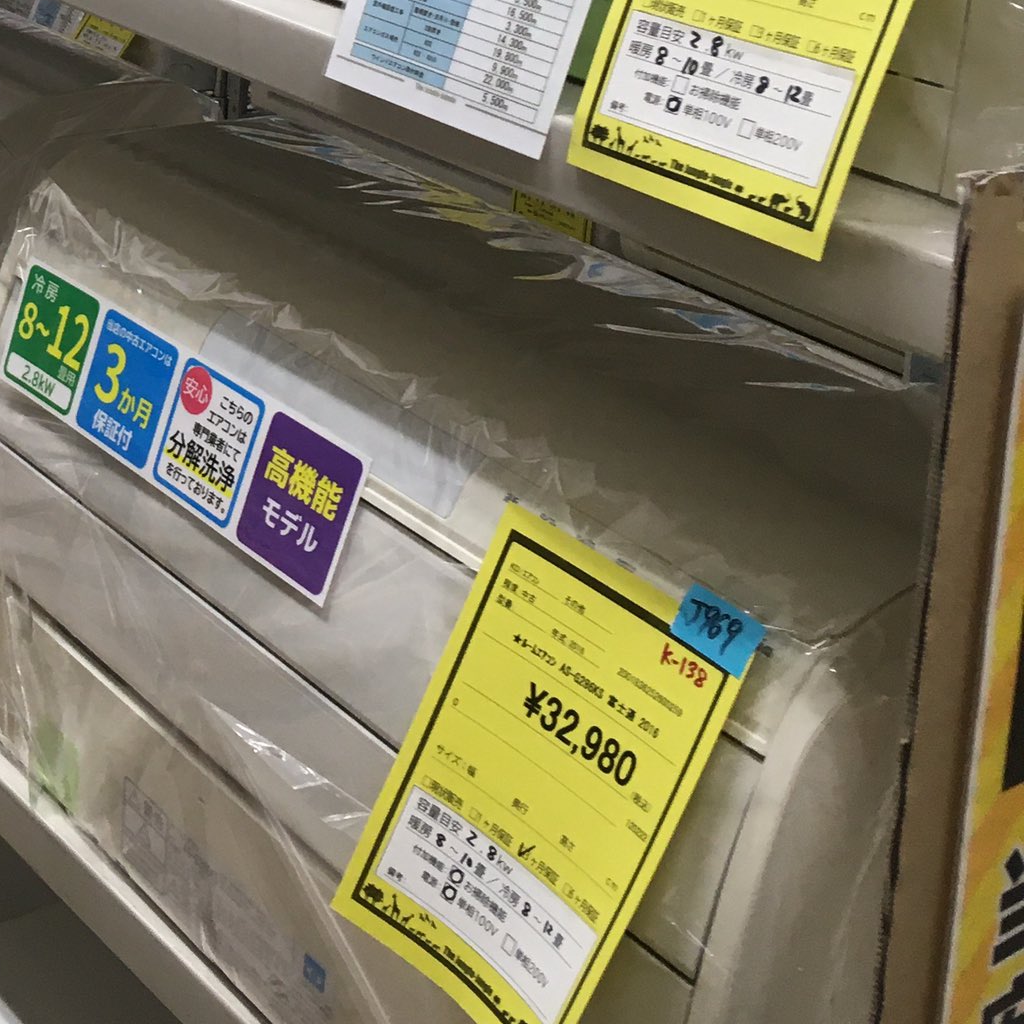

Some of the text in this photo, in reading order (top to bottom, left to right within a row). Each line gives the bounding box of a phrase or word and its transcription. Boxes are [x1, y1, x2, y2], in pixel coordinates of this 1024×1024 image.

[635, 17, 686, 45] 容量目安
[628, 39, 654, 60] 暖房
[653, 45, 670, 66] 8
[728, 69, 755, 90] 冷房
[753, 74, 771, 95] 8
[30, 274, 60, 304] 冷房
[18, 302, 91, 372] 8~12
[106, 319, 173, 368] 当店の中古エアコンは
[21, 364, 56, 397] 2.8kW
[94, 343, 153, 430] 3か月
[183, 377, 209, 405] 安心
[92, 410, 132, 452] 保証付
[206, 410, 248, 445] エアコンは
[219, 395, 254, 426] こちらの
[168, 430, 236, 494] 分解洗浄
[192, 422, 242, 463] 専門業者にて
[165, 462, 227, 515] を行っております。
[263, 446, 344, 522] 高機能
[262, 496, 319, 553] モデル
[523, 682, 637, 786] ¥32,980
[417, 797, 463, 835] 容量目安
[409, 815, 432, 839] 暖房
[435, 833, 446, 847] 8
[499, 884, 520, 907] 冷房
[522, 902, 532, 917] 8
[464, 881, 508, 923] お掃除機能
